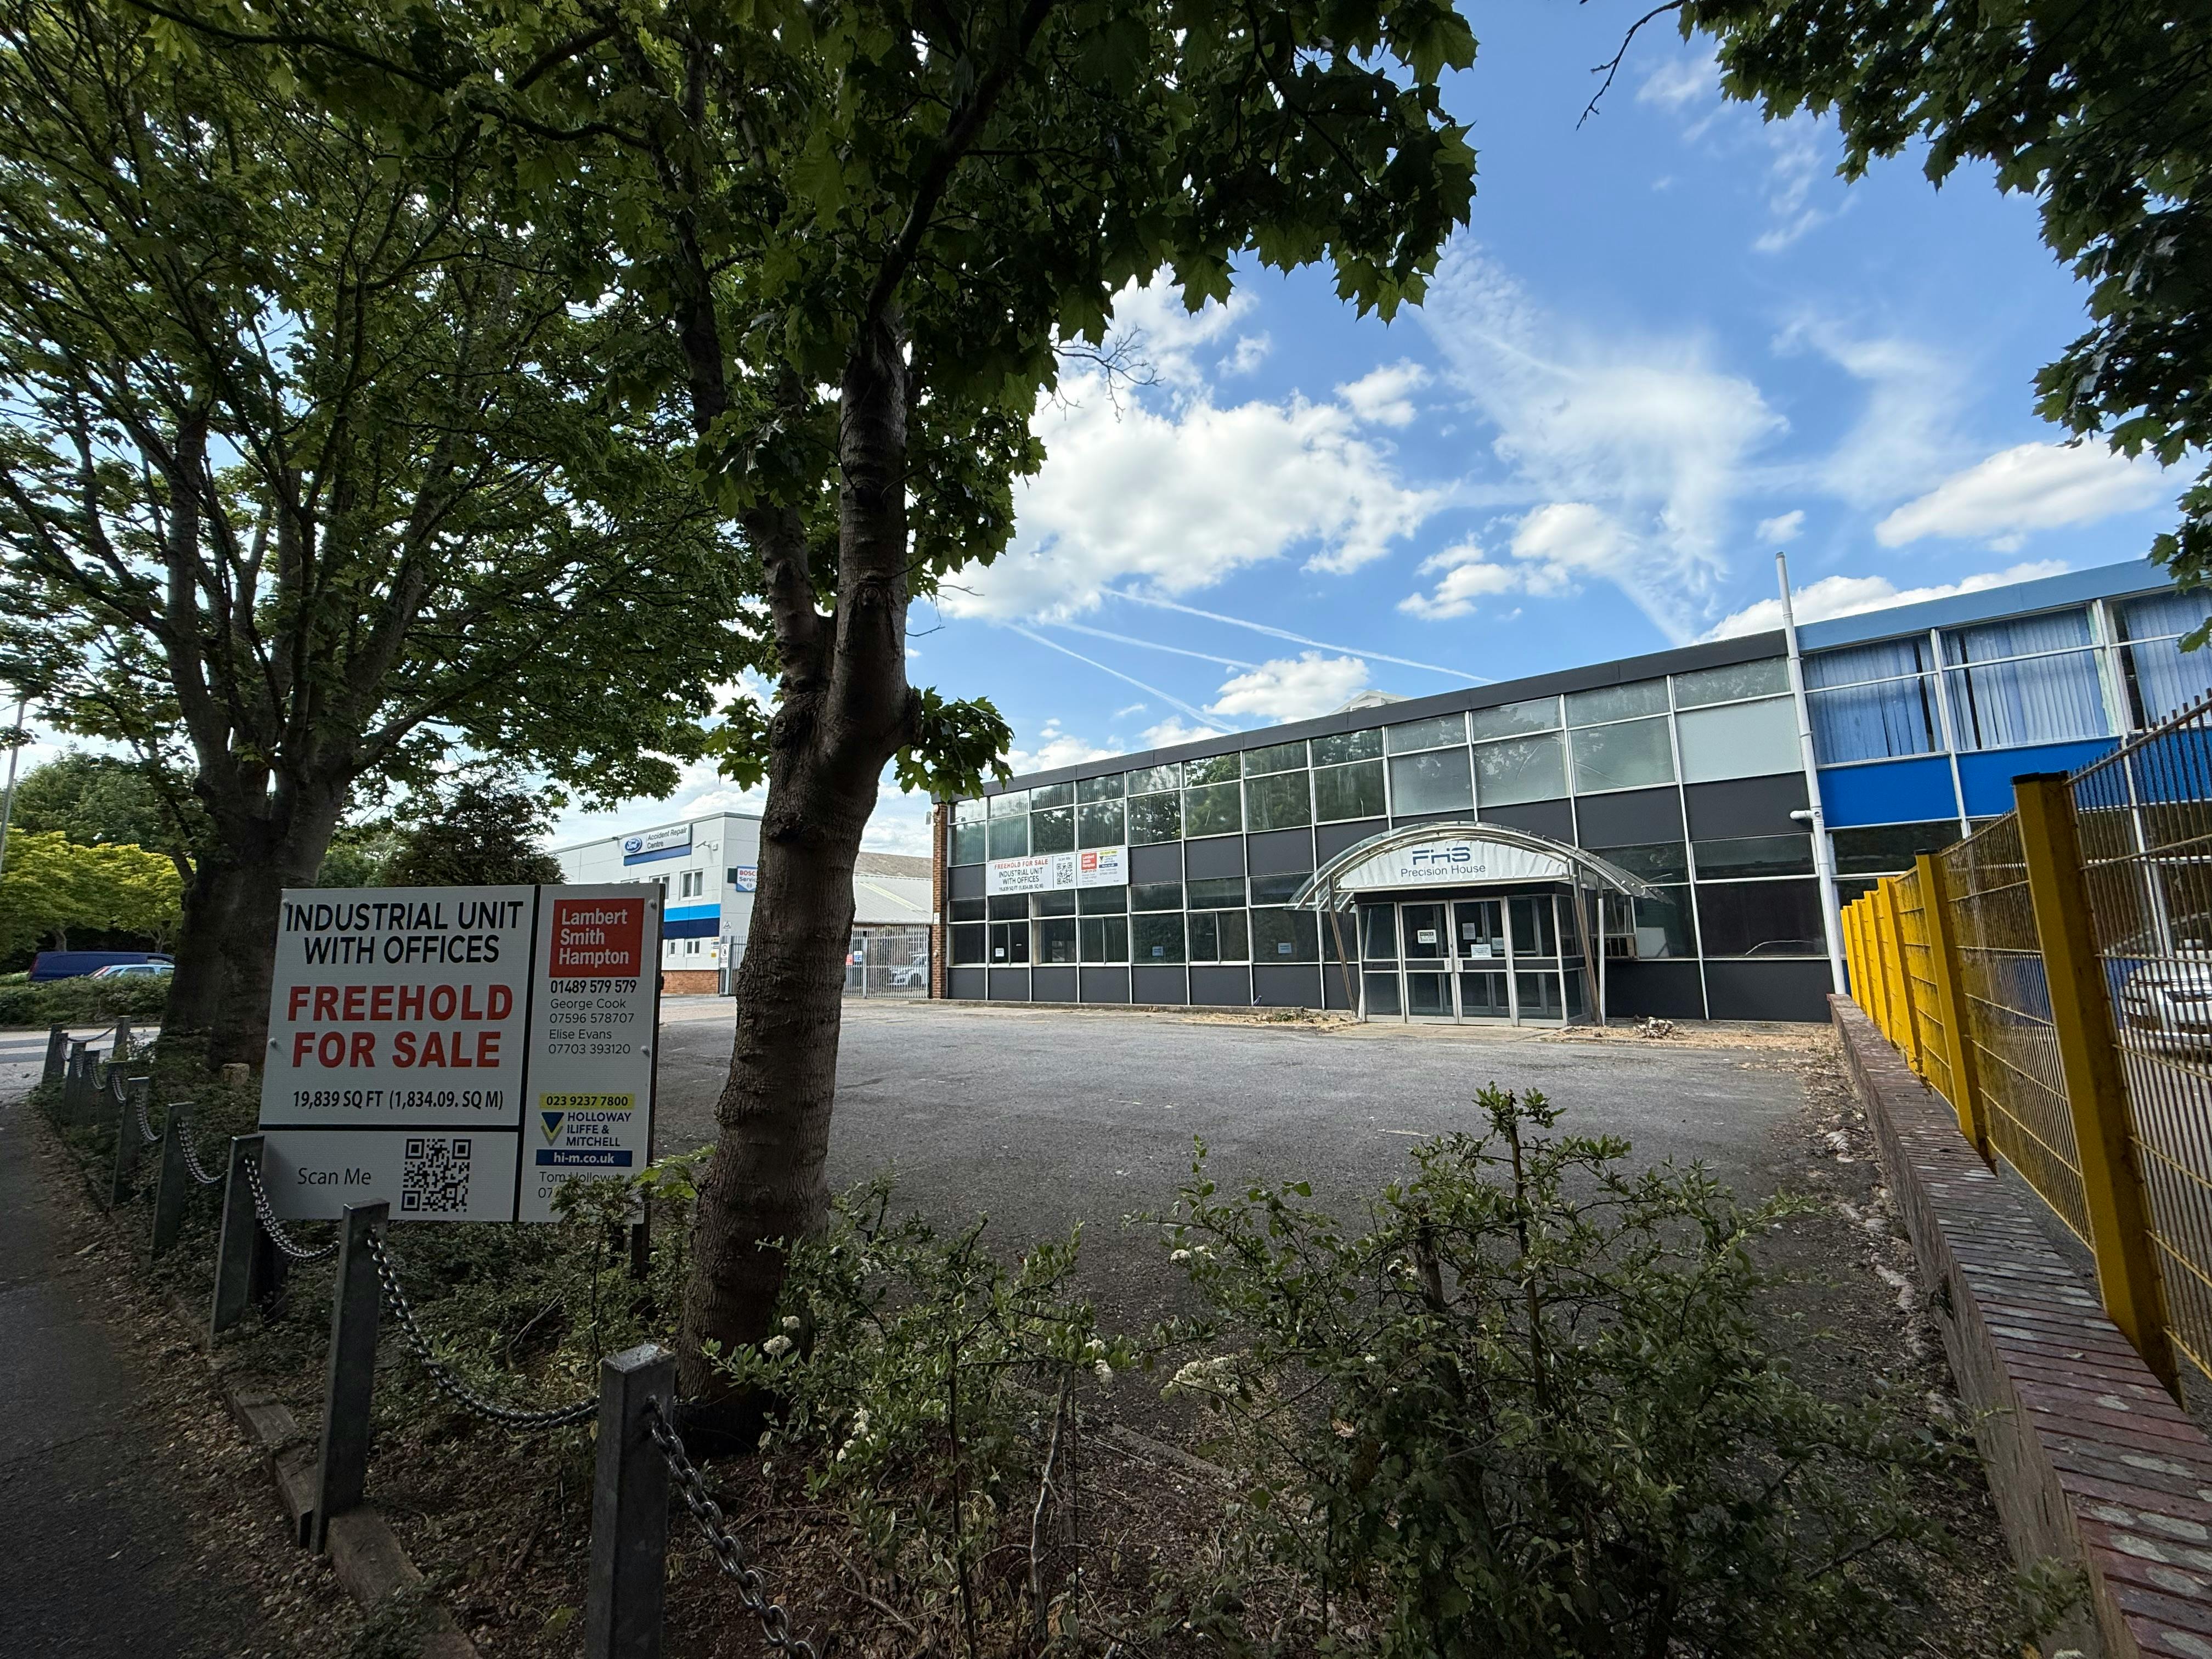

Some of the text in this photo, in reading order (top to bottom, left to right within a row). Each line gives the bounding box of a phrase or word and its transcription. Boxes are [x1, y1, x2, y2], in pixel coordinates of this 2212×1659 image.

[647, 826, 687, 840] Accident Repair
[647, 840, 664, 849] Centre
[1412, 847, 1470, 865] FHS
[994, 861, 1021, 870] FREEHOLD
[1401, 865, 1486, 877] Precision House
[998, 870, 1029, 878] INDUSTRIAL
[1017, 875, 1039, 884] OFFICES
[286, 901, 523, 931] INDUSTRIAL UNIT
[561, 908, 628, 925] Lambert
[560, 928, 605, 945] Smith
[304, 934, 499, 964] WITH OFFICES
[558, 947, 629, 968] Hampton
[550, 979, 637, 994] 01489 579 579
[287, 984, 513, 1021] FREEHOLD
[550, 998, 627, 1011] George Cook
[550, 1013, 634, 1023] 07596 578707
[549, 1029, 612, 1039] Elise Evans
[292, 1031, 501, 1068] FOR SALE
[549, 1043, 630, 1054] 07703 393120
[293, 1090, 504, 1110] 19,839 SQ FT (1,834.09. SQ M)
[546, 1096, 628, 1106] 023 9237 7800
[568, 1112, 631, 1122] HOLLOWAY
[567, 1124, 610, 1134] ILIFFE &
[566, 1137, 620, 1147] MITCHELL
[553, 1152, 614, 1164] hi-m.co.uk
[297, 1167, 371, 1185] Scan Me
[539, 1171, 566, 1182] Tom
